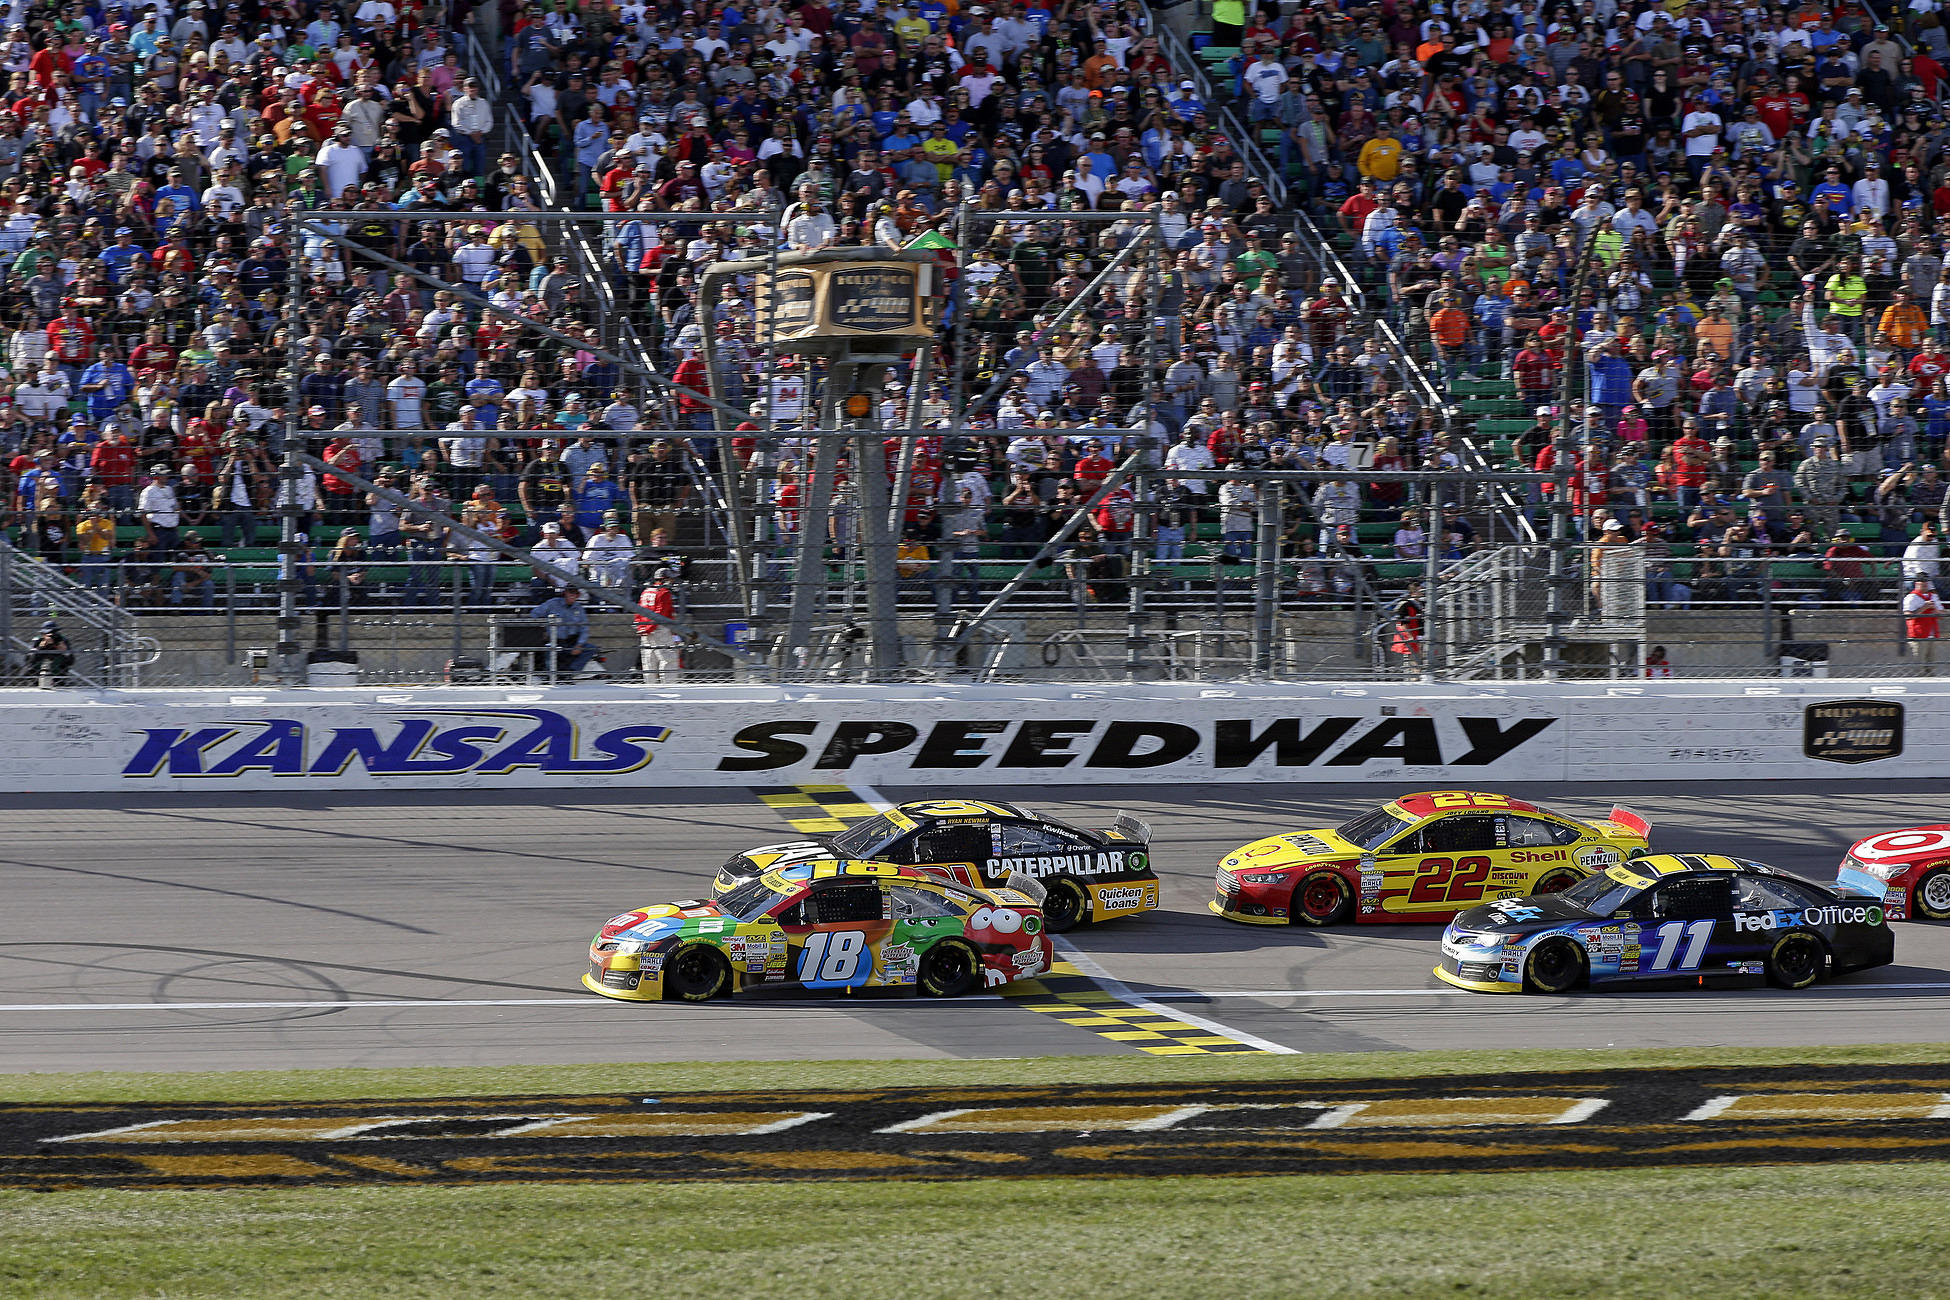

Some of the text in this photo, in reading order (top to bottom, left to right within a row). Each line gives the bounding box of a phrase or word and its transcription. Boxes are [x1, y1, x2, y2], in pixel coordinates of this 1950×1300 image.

[1353, 444, 1368, 466] 7
[121, 708, 671, 778] KANSAS
[715, 717, 1559, 772] SPEEDWAY
[1430, 792, 1511, 809] 22
[963, 817, 990, 825] NEWMAN
[1042, 824, 1079, 841] Kwikset
[987, 851, 1126, 879] CATERPILLAR
[1510, 850, 1567, 864] Shell
[1579, 853, 1621, 866] PENNZOIL
[1408, 855, 1491, 904] 22
[1491, 872, 1529, 881] DISCOUNT
[1099, 886, 1143, 901] Quicken
[1105, 897, 1141, 911] Loans
[1732, 905, 1866, 932] FedEx Office
[1537, 930, 1575, 941] GOODYEAR
[1587, 935, 1600, 943] 3M
[730, 943, 746, 952] 3M
[1648, 919, 1717, 973] 11
[800, 930, 866, 982] 18
